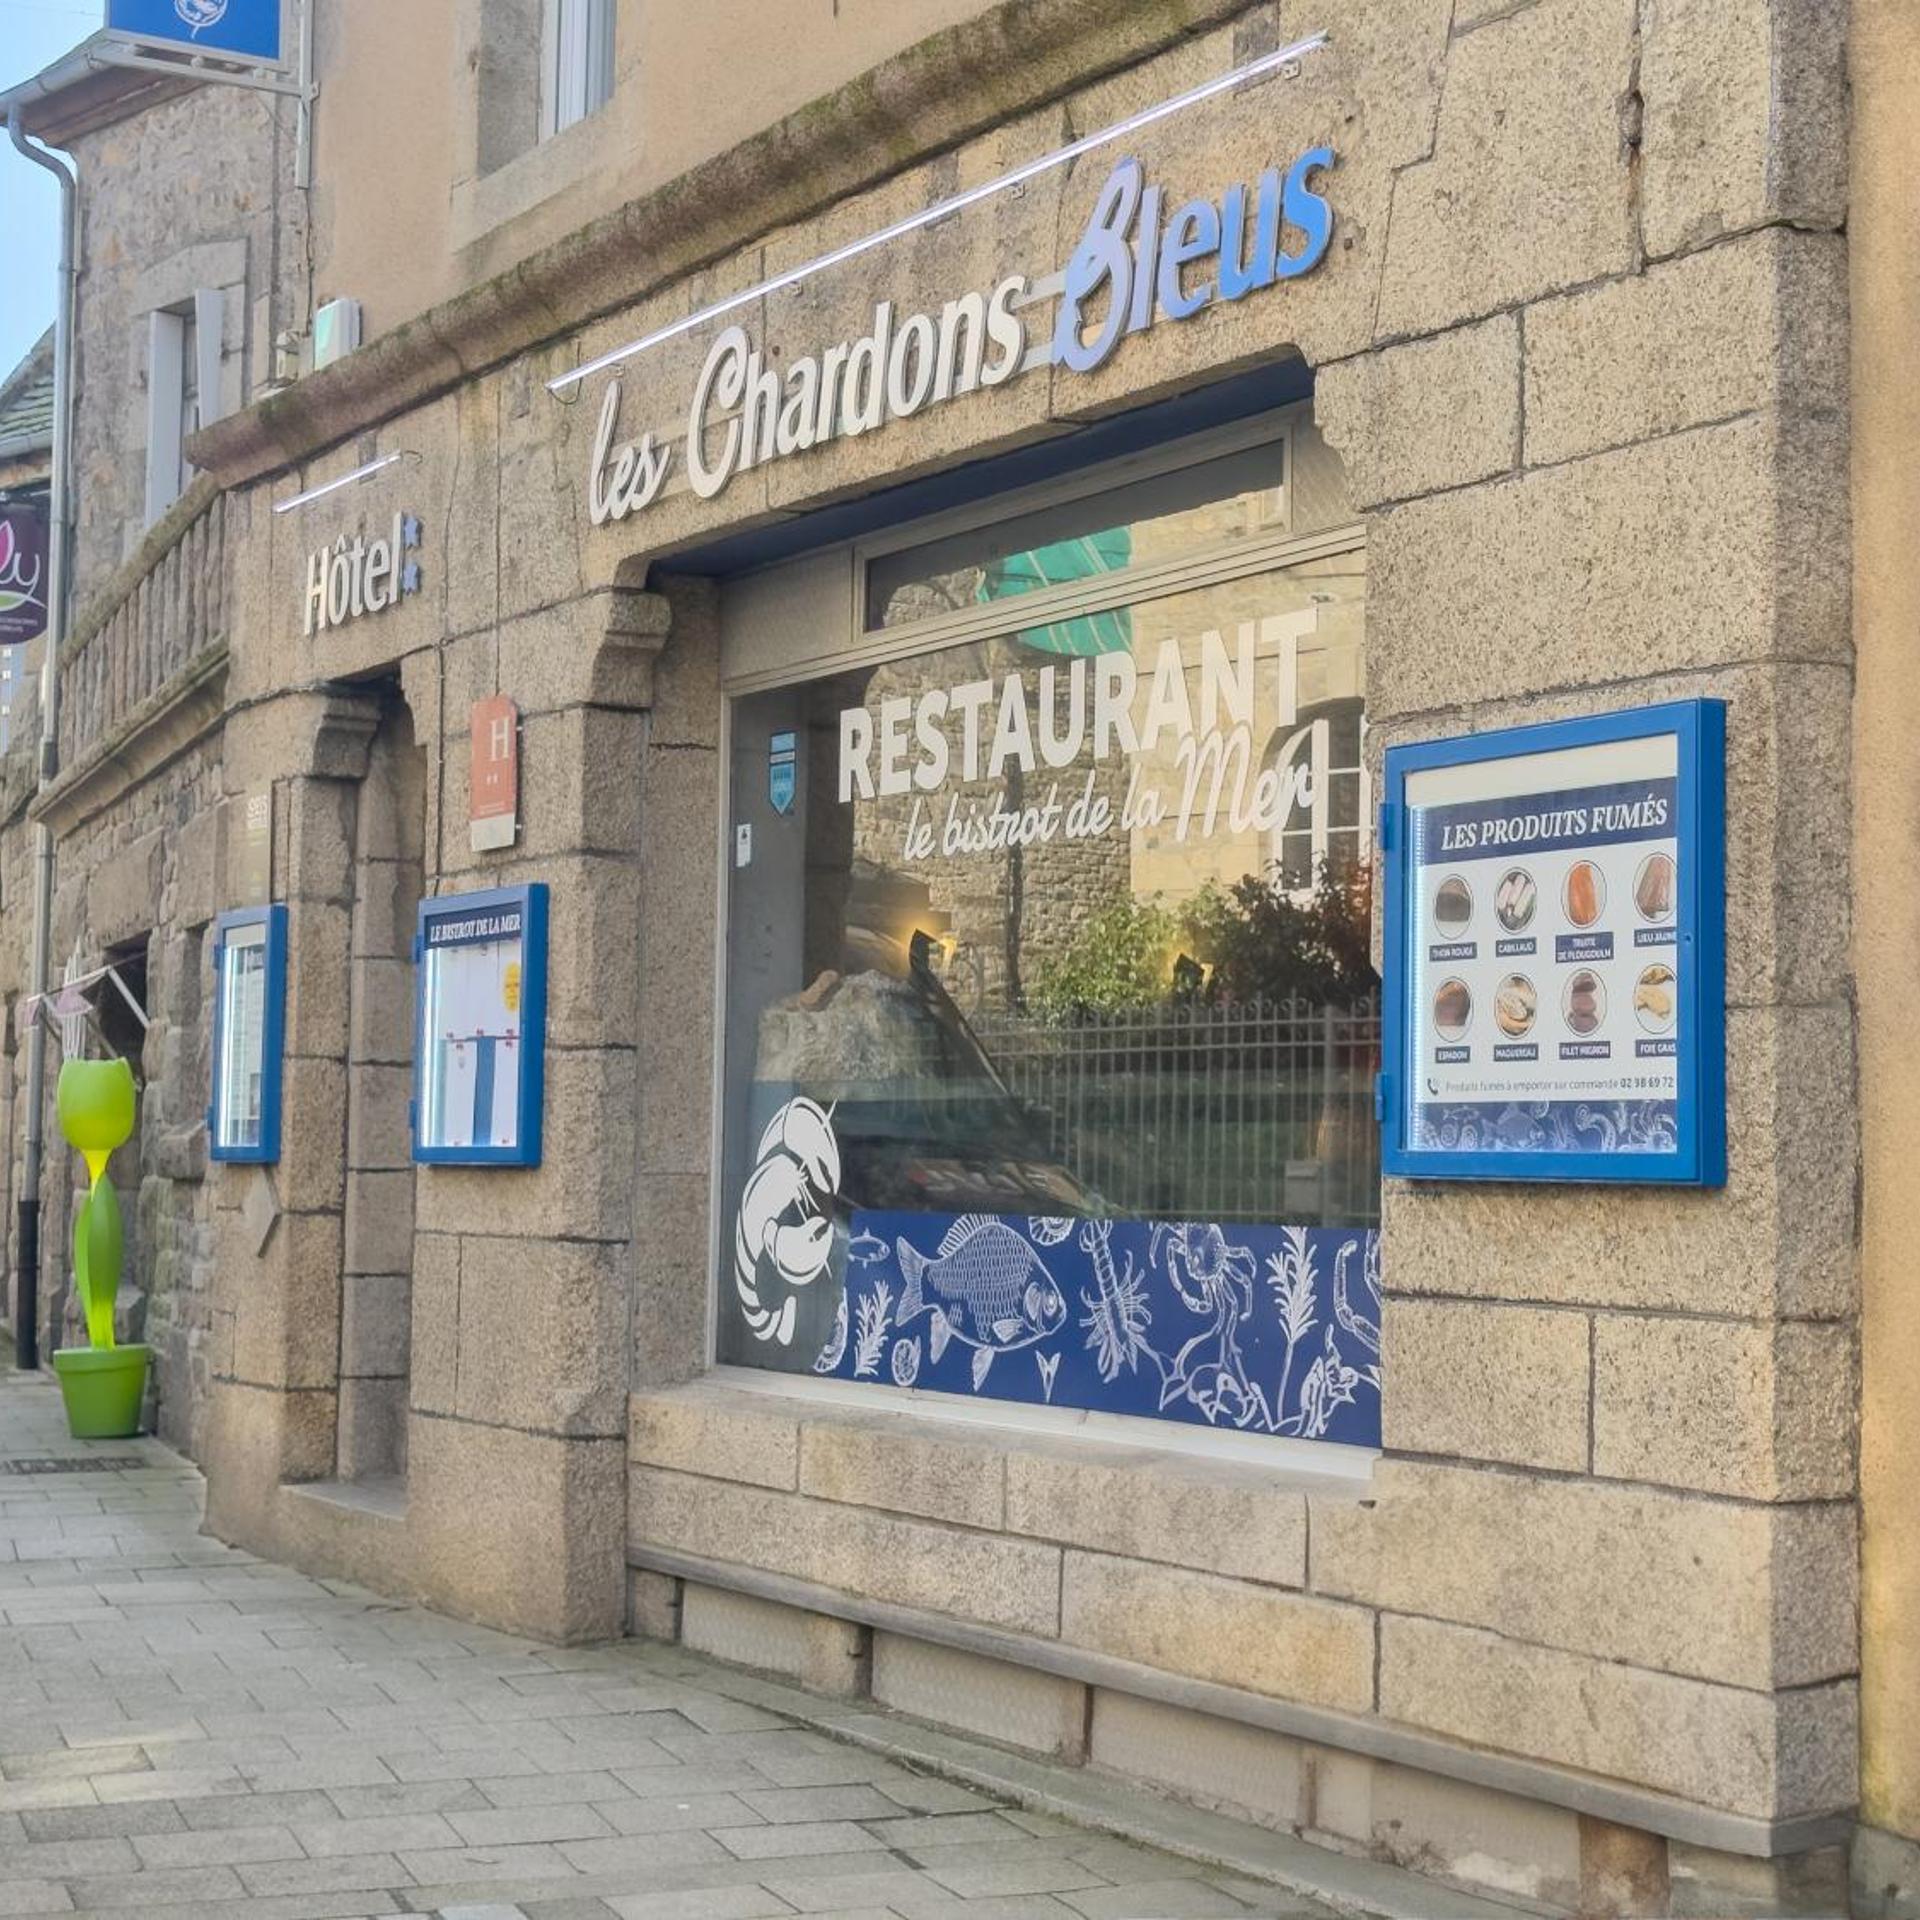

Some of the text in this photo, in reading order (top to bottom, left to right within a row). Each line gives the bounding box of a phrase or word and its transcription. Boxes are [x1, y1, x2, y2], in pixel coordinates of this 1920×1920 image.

[686, 274, 1030, 499] Chardons
[1051, 146, 1338, 373] Bleus
[304, 511, 402, 637] Hôtel
[490, 716, 510, 762] H
[838, 608, 1319, 803] RESTAURANT
[904, 718, 1318, 861] le bistrot de la Mer
[1441, 793, 1669, 851] LES PRODUITS FUMÉS
[430, 913, 521, 942] LE BISTROT DE LA MER
[1662, 1076, 1674, 1088] 72
